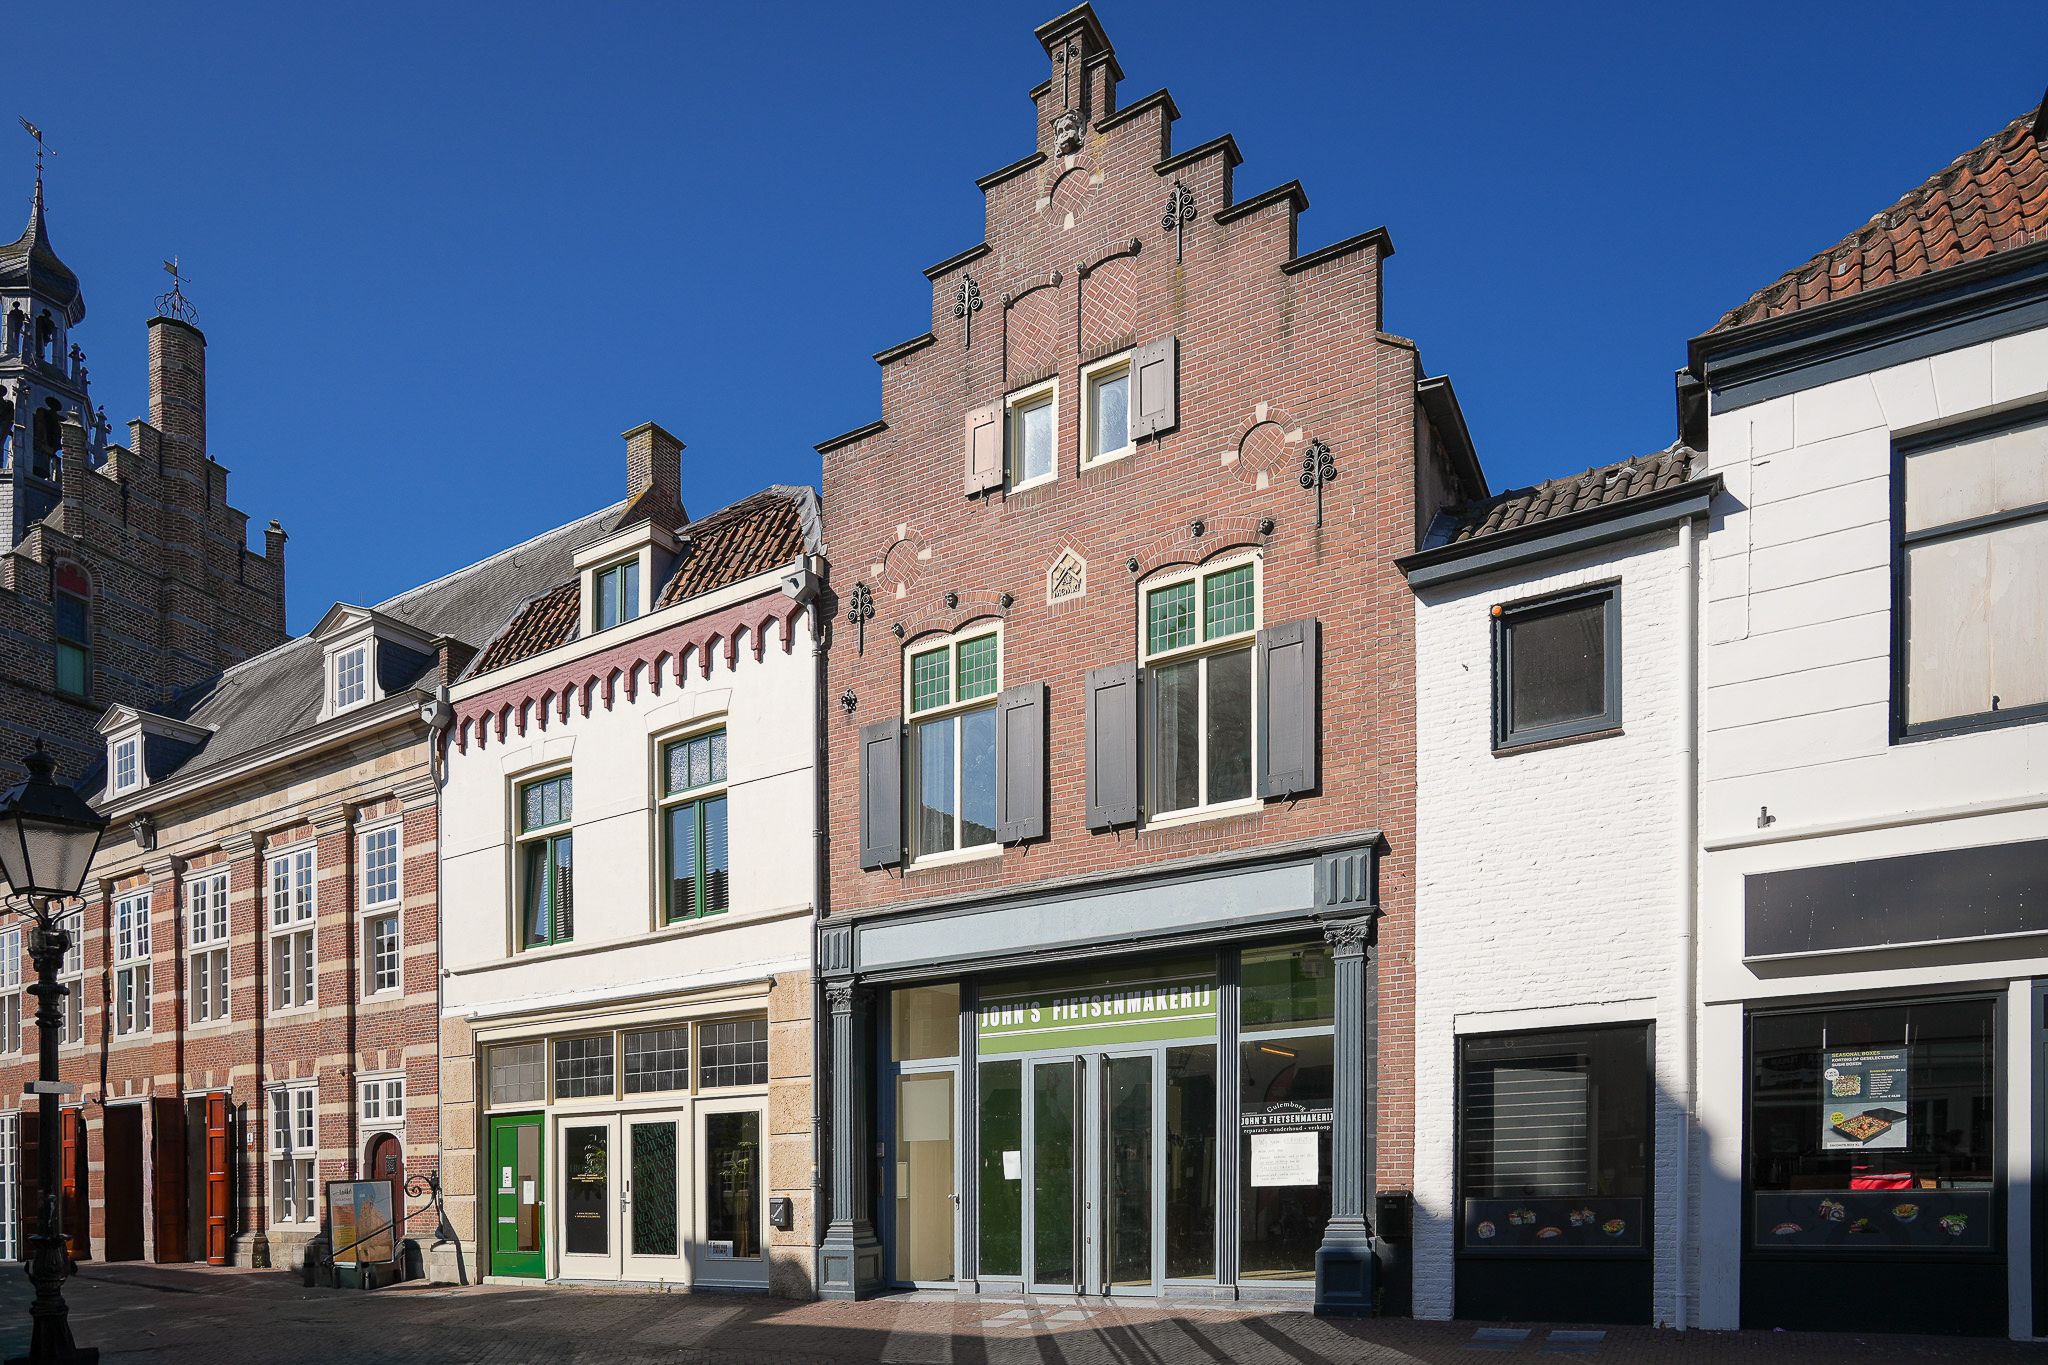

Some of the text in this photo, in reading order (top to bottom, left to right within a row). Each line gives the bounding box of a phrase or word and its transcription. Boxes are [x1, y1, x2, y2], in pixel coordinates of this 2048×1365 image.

[981, 984, 1210, 1028] JOHN'S FIETSENMAKERIJ
[1266, 1101, 1307, 1113] Culemborg
[1241, 1117, 1267, 1126] JOHN'S
[1269, 1113, 1334, 1124] FIETSENMAKERIJ
